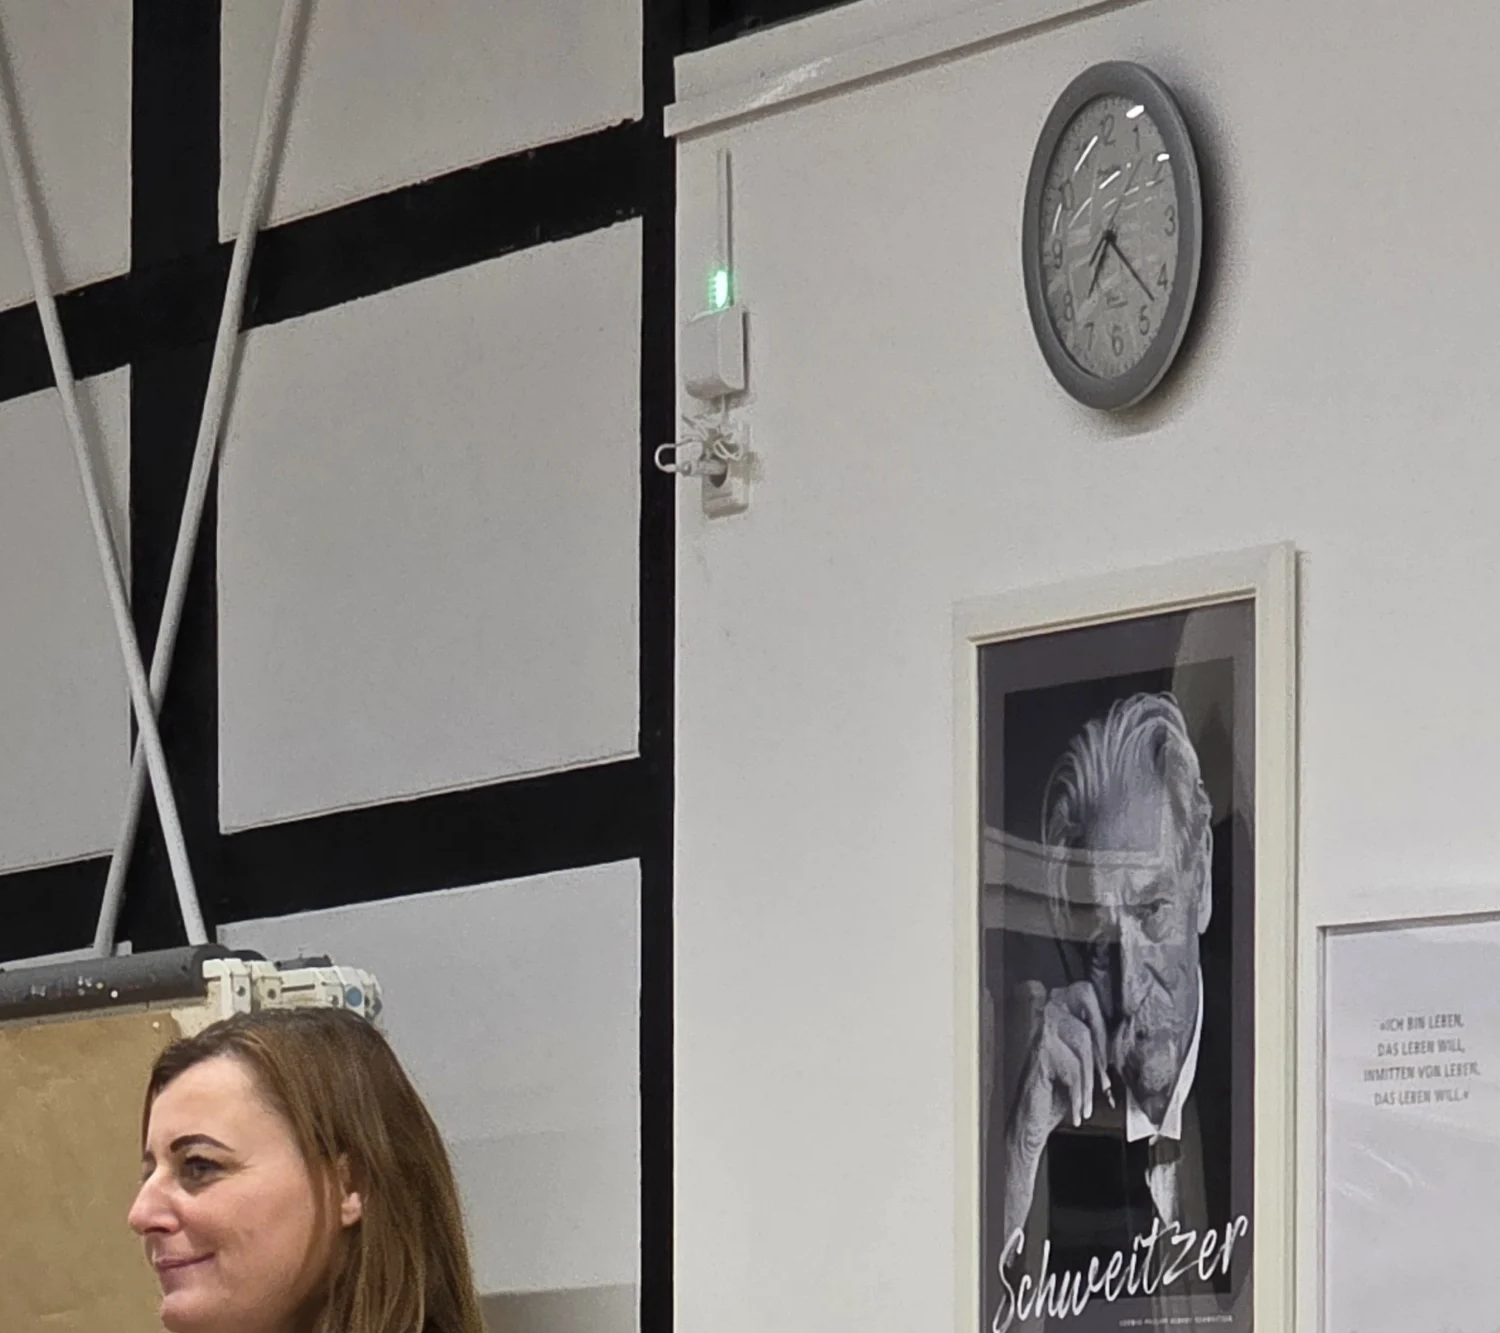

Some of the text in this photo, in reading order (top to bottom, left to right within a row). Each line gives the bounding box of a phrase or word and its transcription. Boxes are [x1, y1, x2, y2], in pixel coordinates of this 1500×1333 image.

[1164, 205, 1176, 238] 3
[1052, 239, 1064, 270] 9
[1156, 262, 1169, 291] 4
[1063, 291, 1075, 322] 8
[1139, 303, 1150, 336] 5
[1083, 320, 1095, 352] 7
[1111, 322, 1125, 357] 6
[1377, 1042, 1400, 1057] DAS
[1401, 1039, 1435, 1056] LEBEN
[1417, 1064, 1442, 1079] VON
[1374, 1091, 1396, 1106] DAS
[1398, 1089, 1431, 1106] LEBEN
